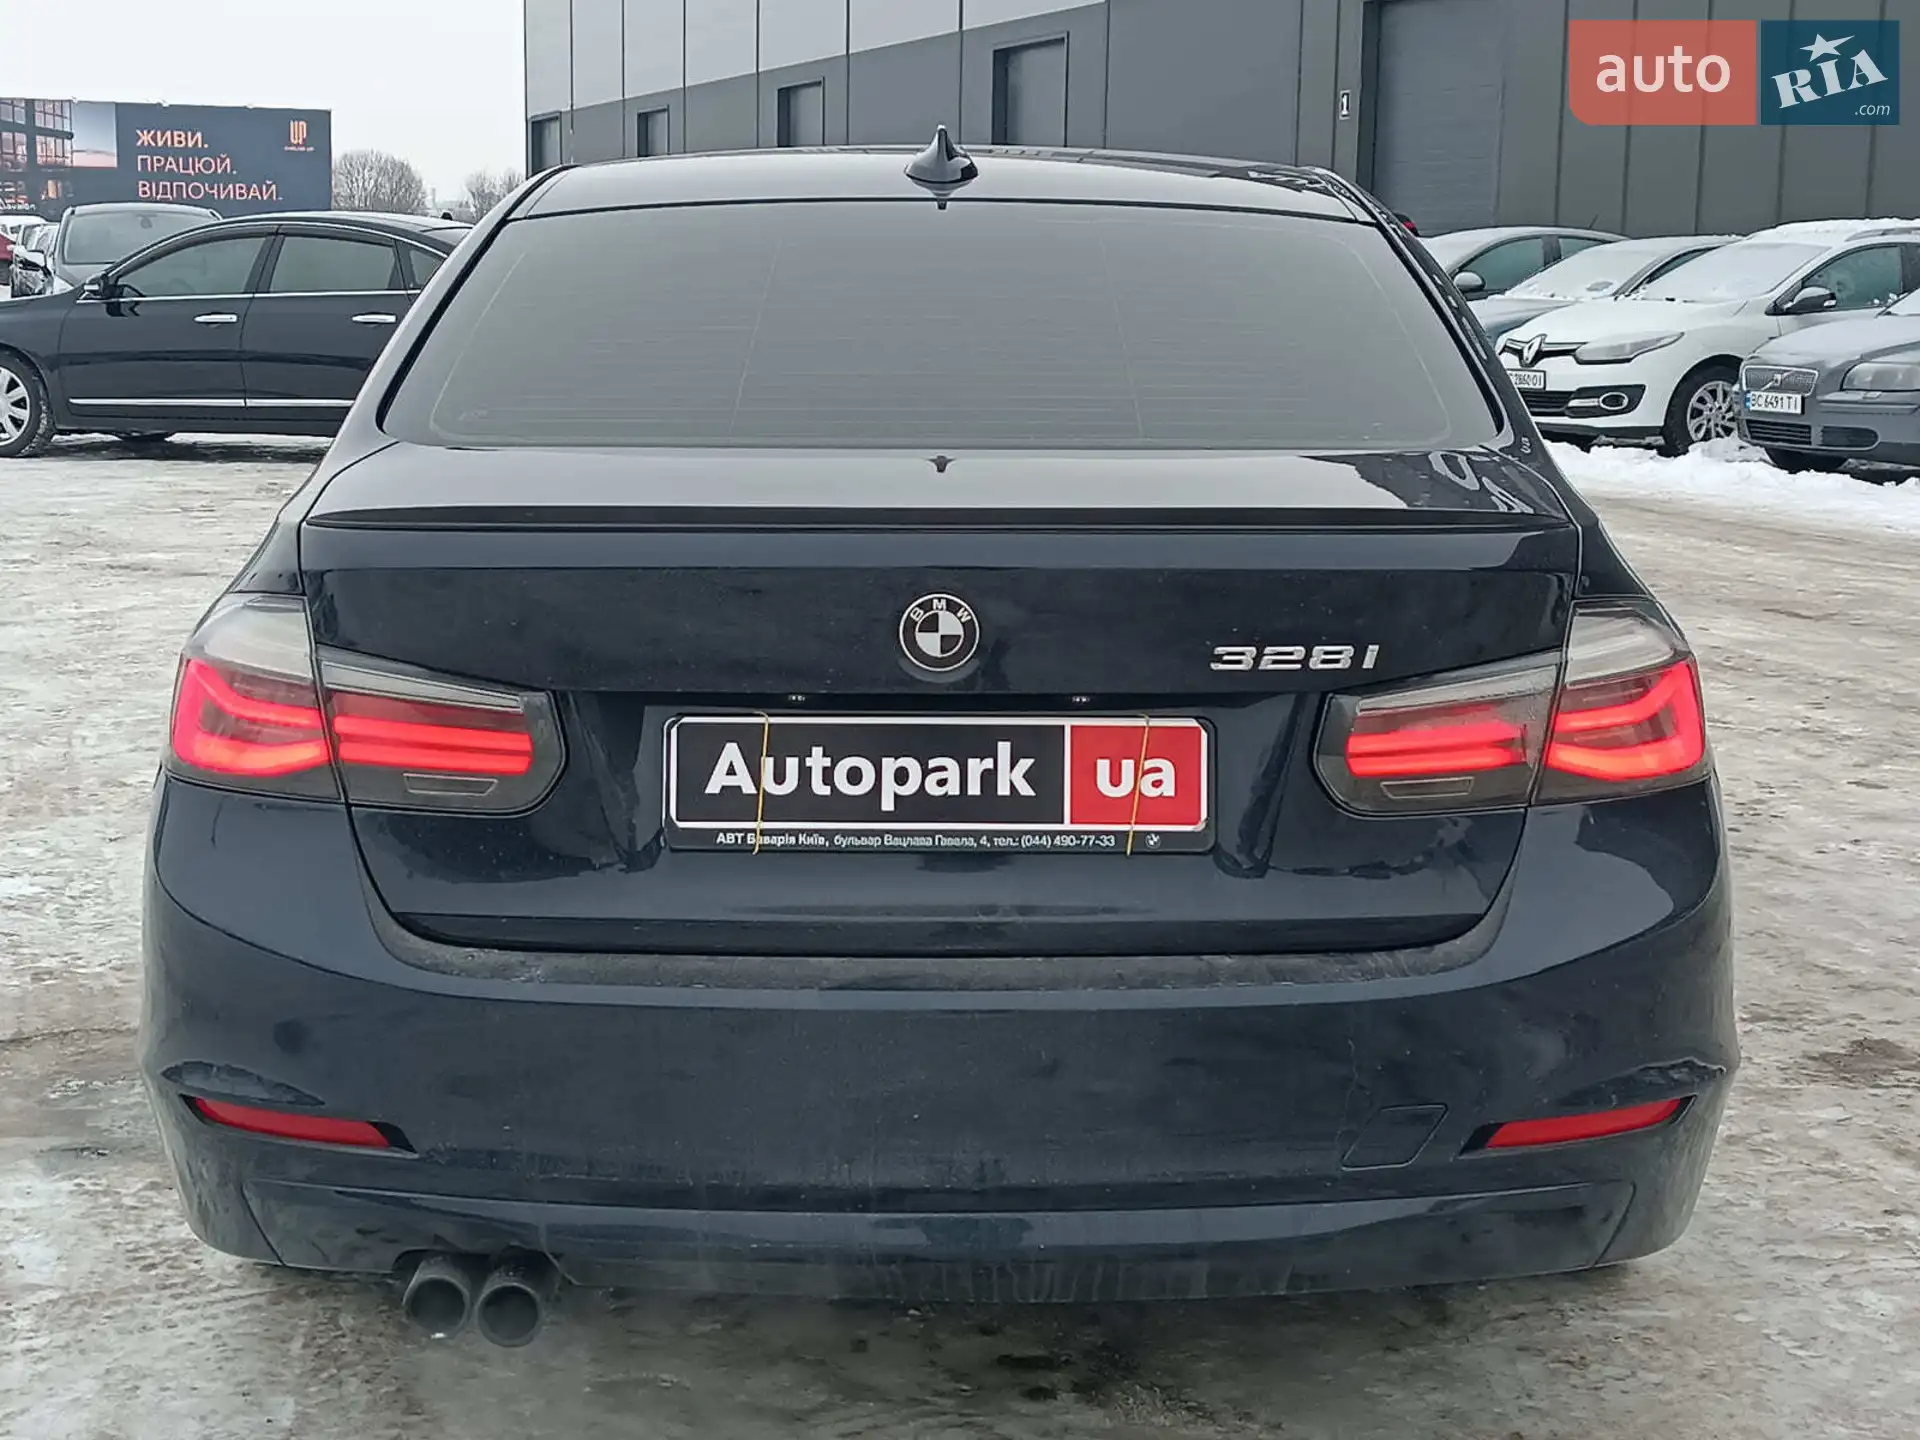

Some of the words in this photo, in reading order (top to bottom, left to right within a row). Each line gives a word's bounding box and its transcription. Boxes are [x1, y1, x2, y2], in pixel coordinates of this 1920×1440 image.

[1341, 94, 1349, 115] 1
[136, 129, 209, 149] ЖИВИ.
[137, 153, 237, 176] ПРАЦЮЙ.
[138, 180, 284, 202] ВІДПОЧИВАЙ.
[910, 599, 971, 623] BMW
[704, 741, 1036, 811] Autopark
[1095, 756, 1175, 797] ua
[1021, 835, 1051, 848] (044)
[1053, 835, 1116, 847] 490-77-33
